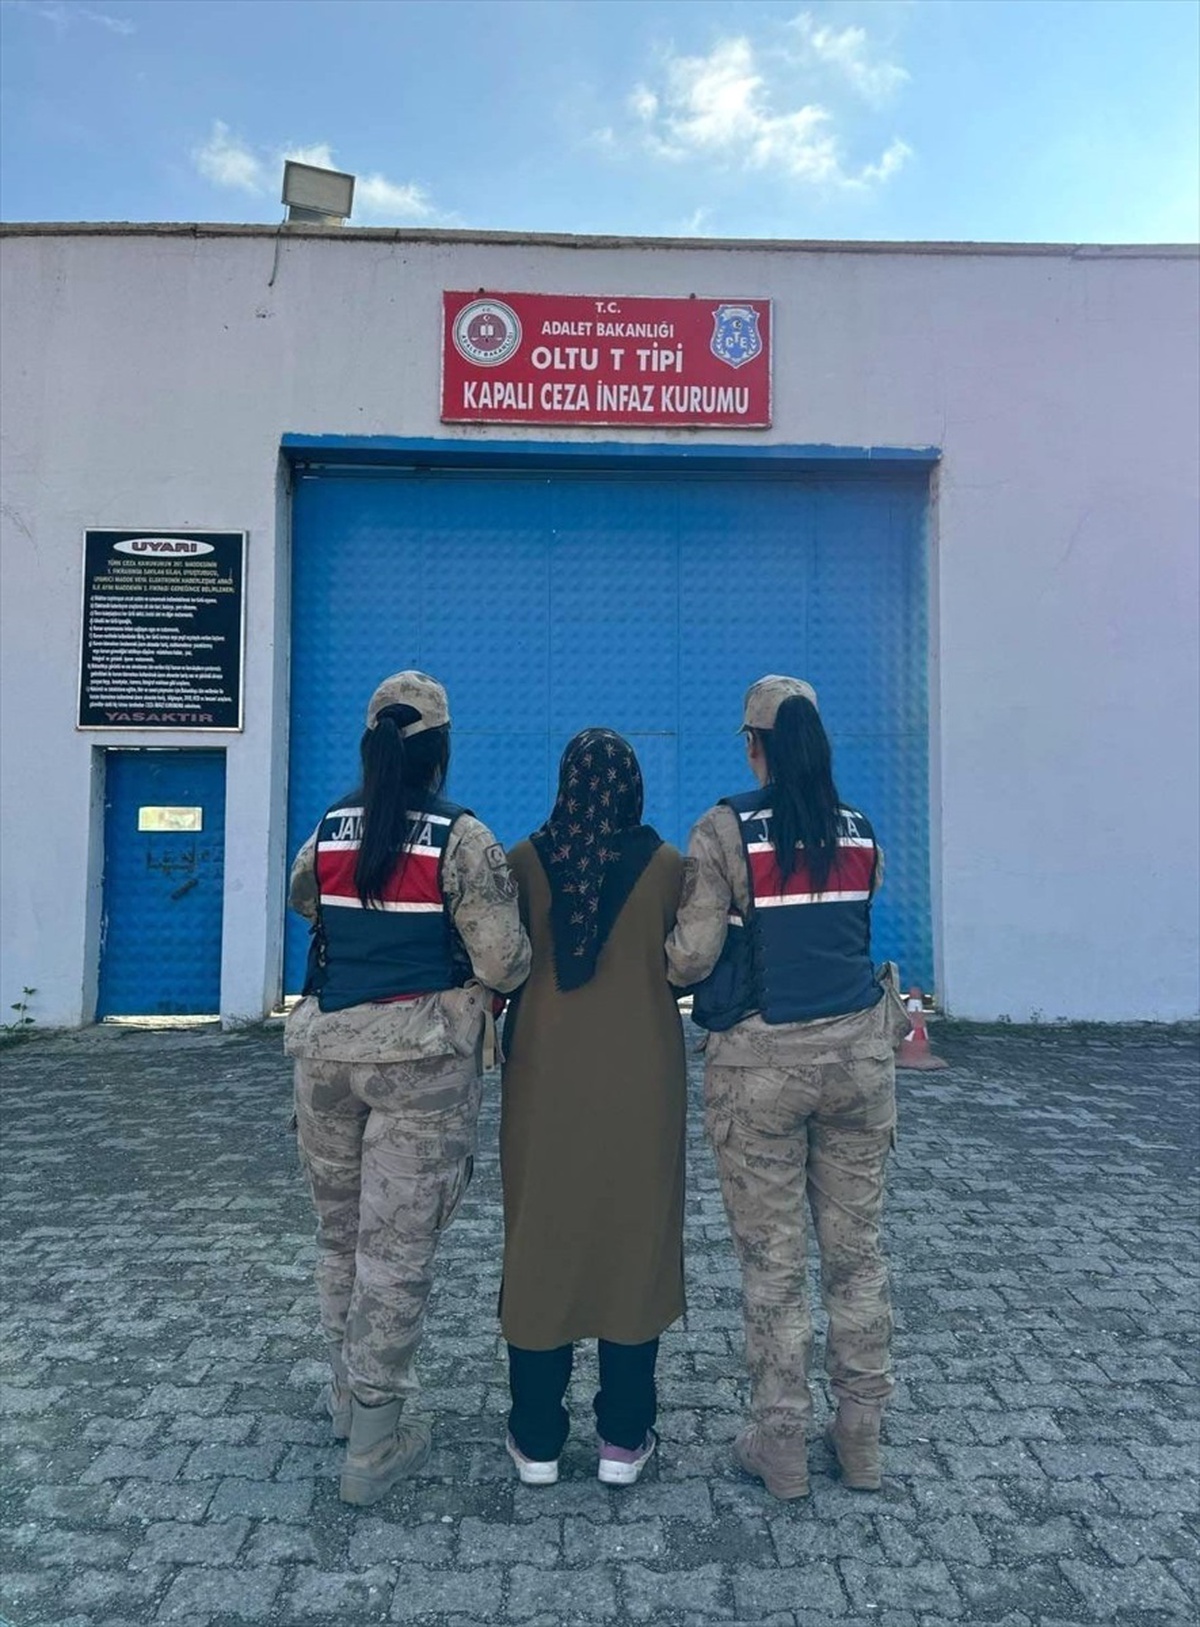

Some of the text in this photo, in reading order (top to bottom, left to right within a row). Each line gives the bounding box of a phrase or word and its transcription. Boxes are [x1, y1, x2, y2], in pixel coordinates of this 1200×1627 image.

[595, 302, 621, 314] T.C.
[541, 321, 674, 338] ADALET BAKANLIĞI
[531, 342, 683, 373] OLTU T TİPİ
[463, 379, 749, 414] KAPALI CEZA İNFAZ KURUMU
[131, 541, 198, 553] UYARI
[105, 712, 214, 723] YASAKTIR
